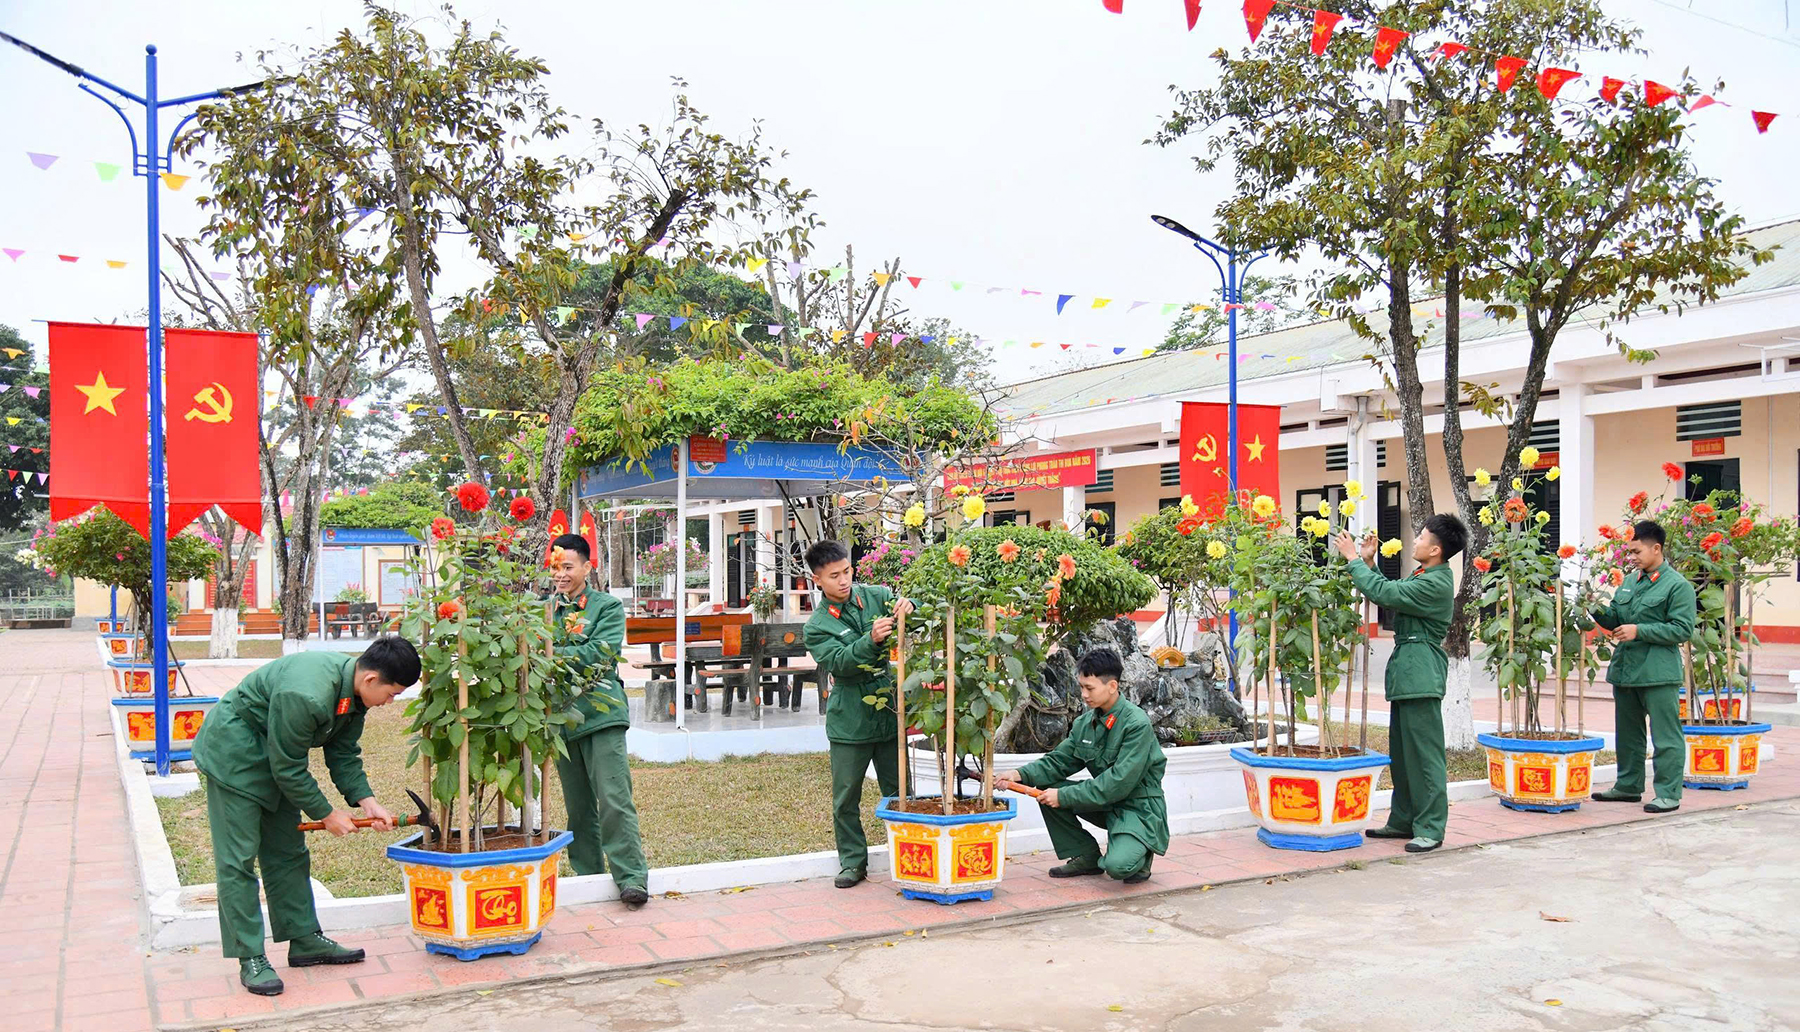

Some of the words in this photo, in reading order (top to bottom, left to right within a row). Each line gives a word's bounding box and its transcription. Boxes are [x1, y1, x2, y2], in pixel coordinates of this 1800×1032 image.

[758, 453, 774, 467] luật
[775, 453, 783, 467] là
[785, 456, 799, 467] sức
[800, 455, 823, 468] mạnh
